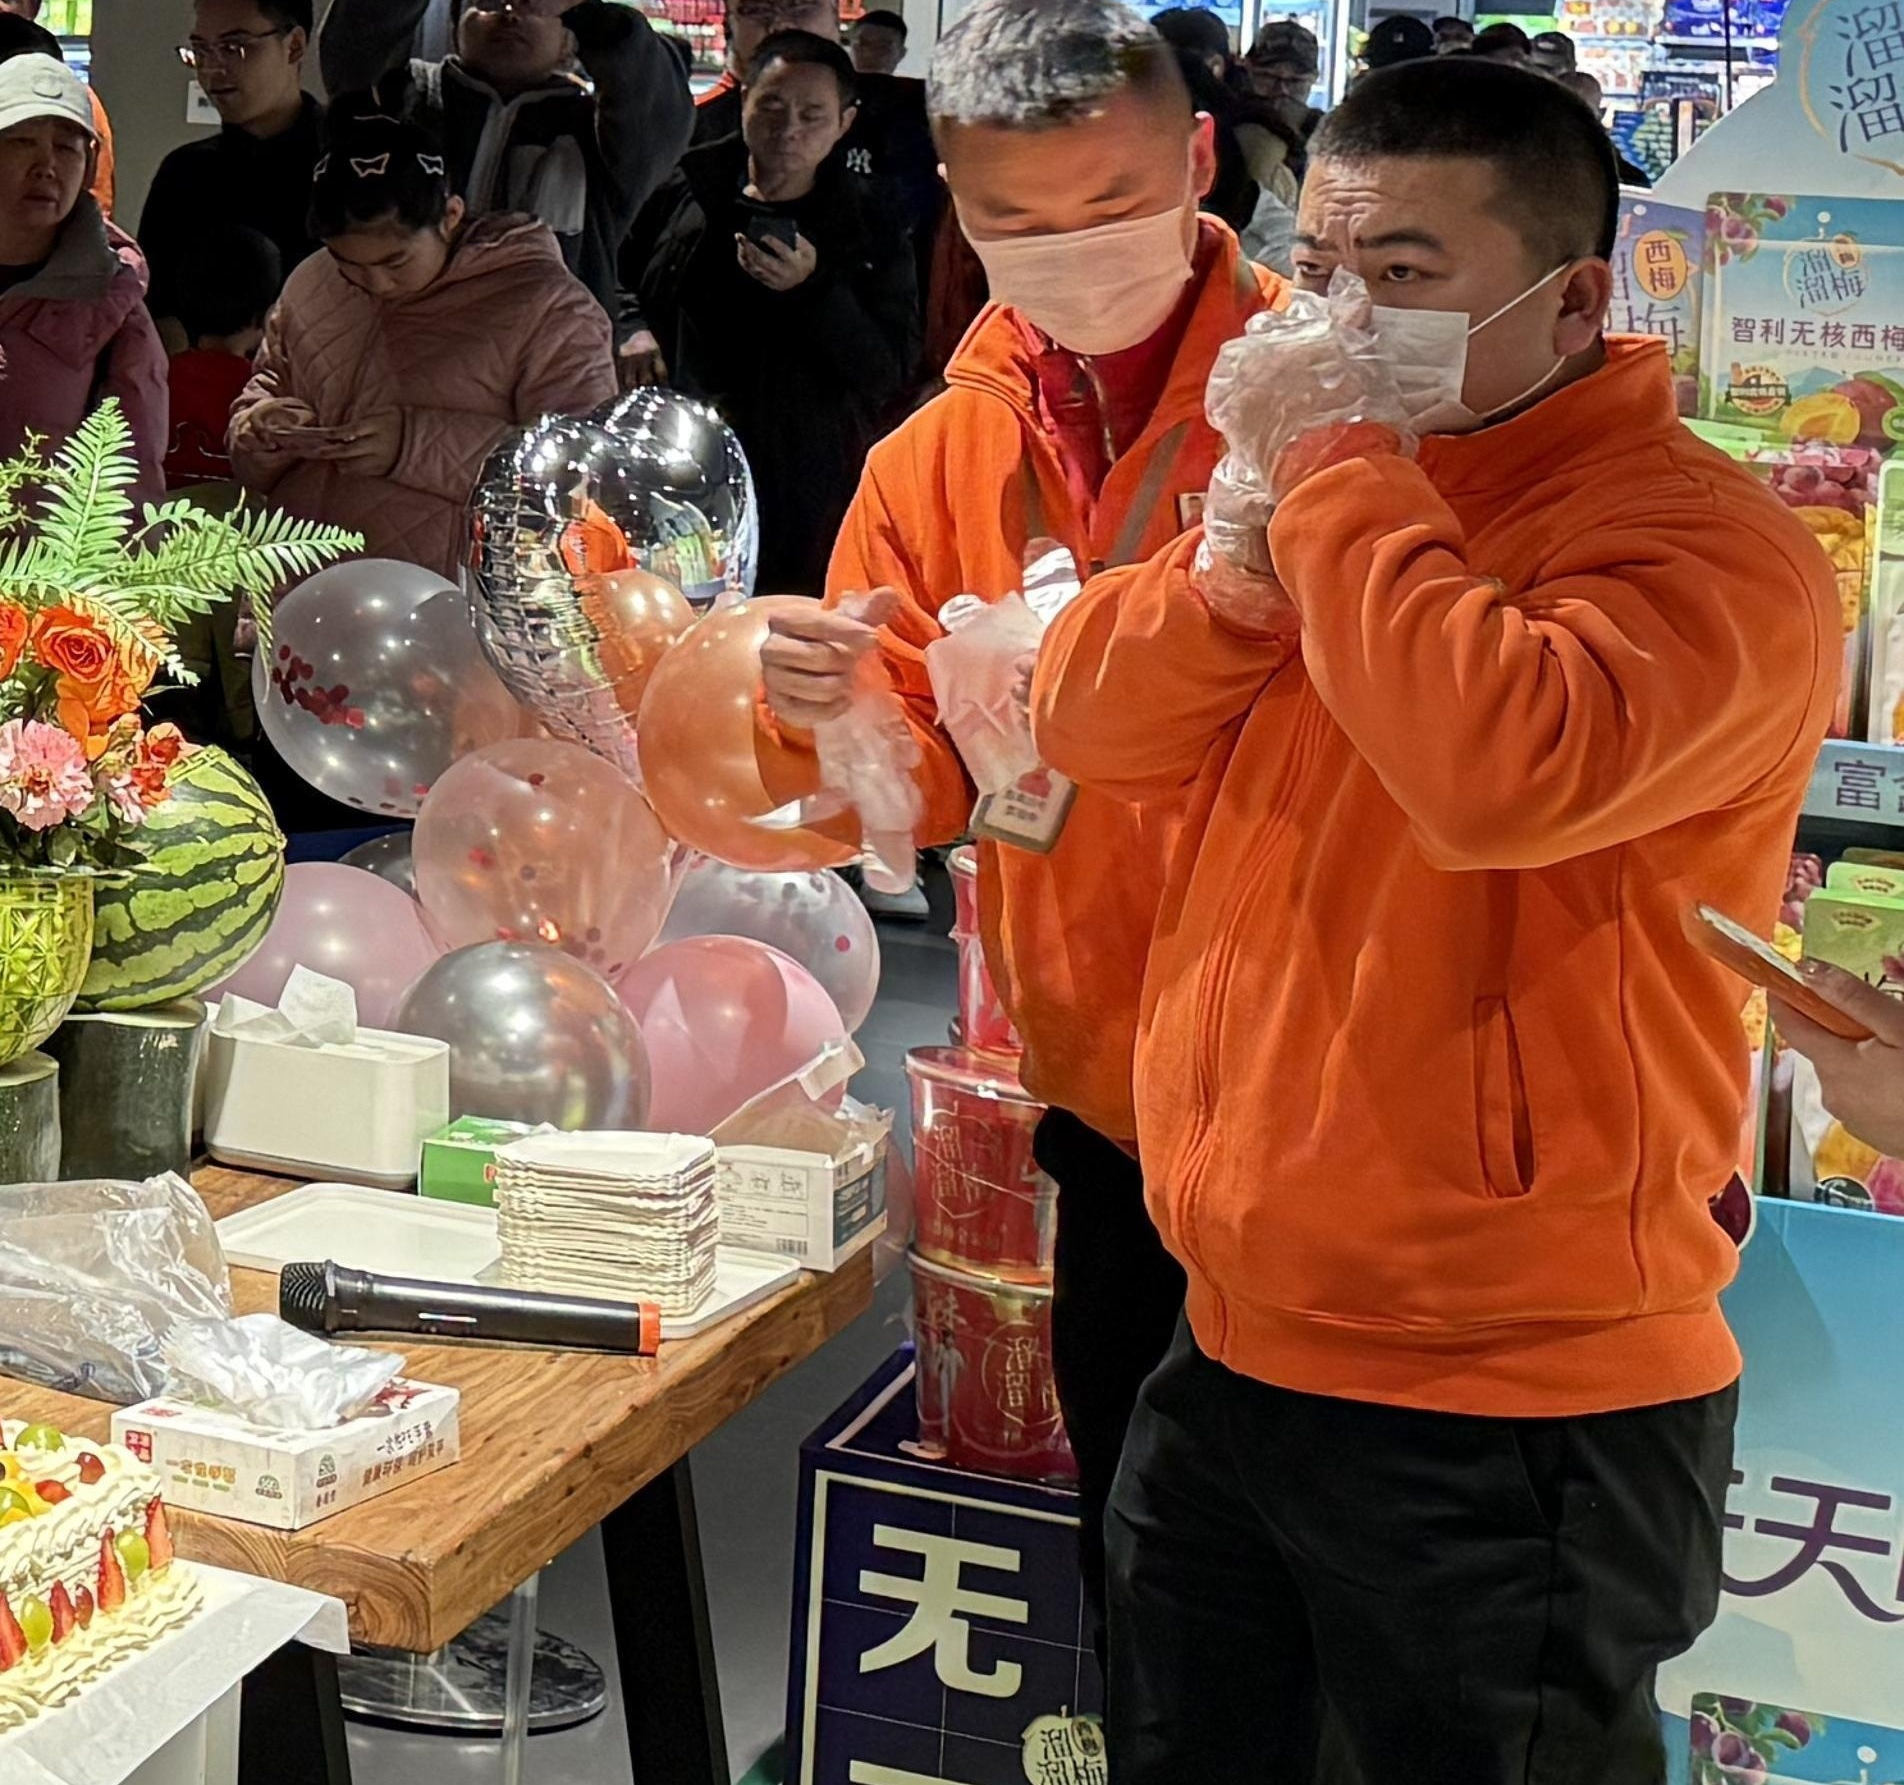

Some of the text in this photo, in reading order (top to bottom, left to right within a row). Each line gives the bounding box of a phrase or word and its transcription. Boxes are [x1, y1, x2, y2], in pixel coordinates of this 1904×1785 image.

[1642, 239, 1677, 293] 西梅
[1731, 316, 1904, 353] 智利无核西梅
[1835, 760, 1904, 813] 富
